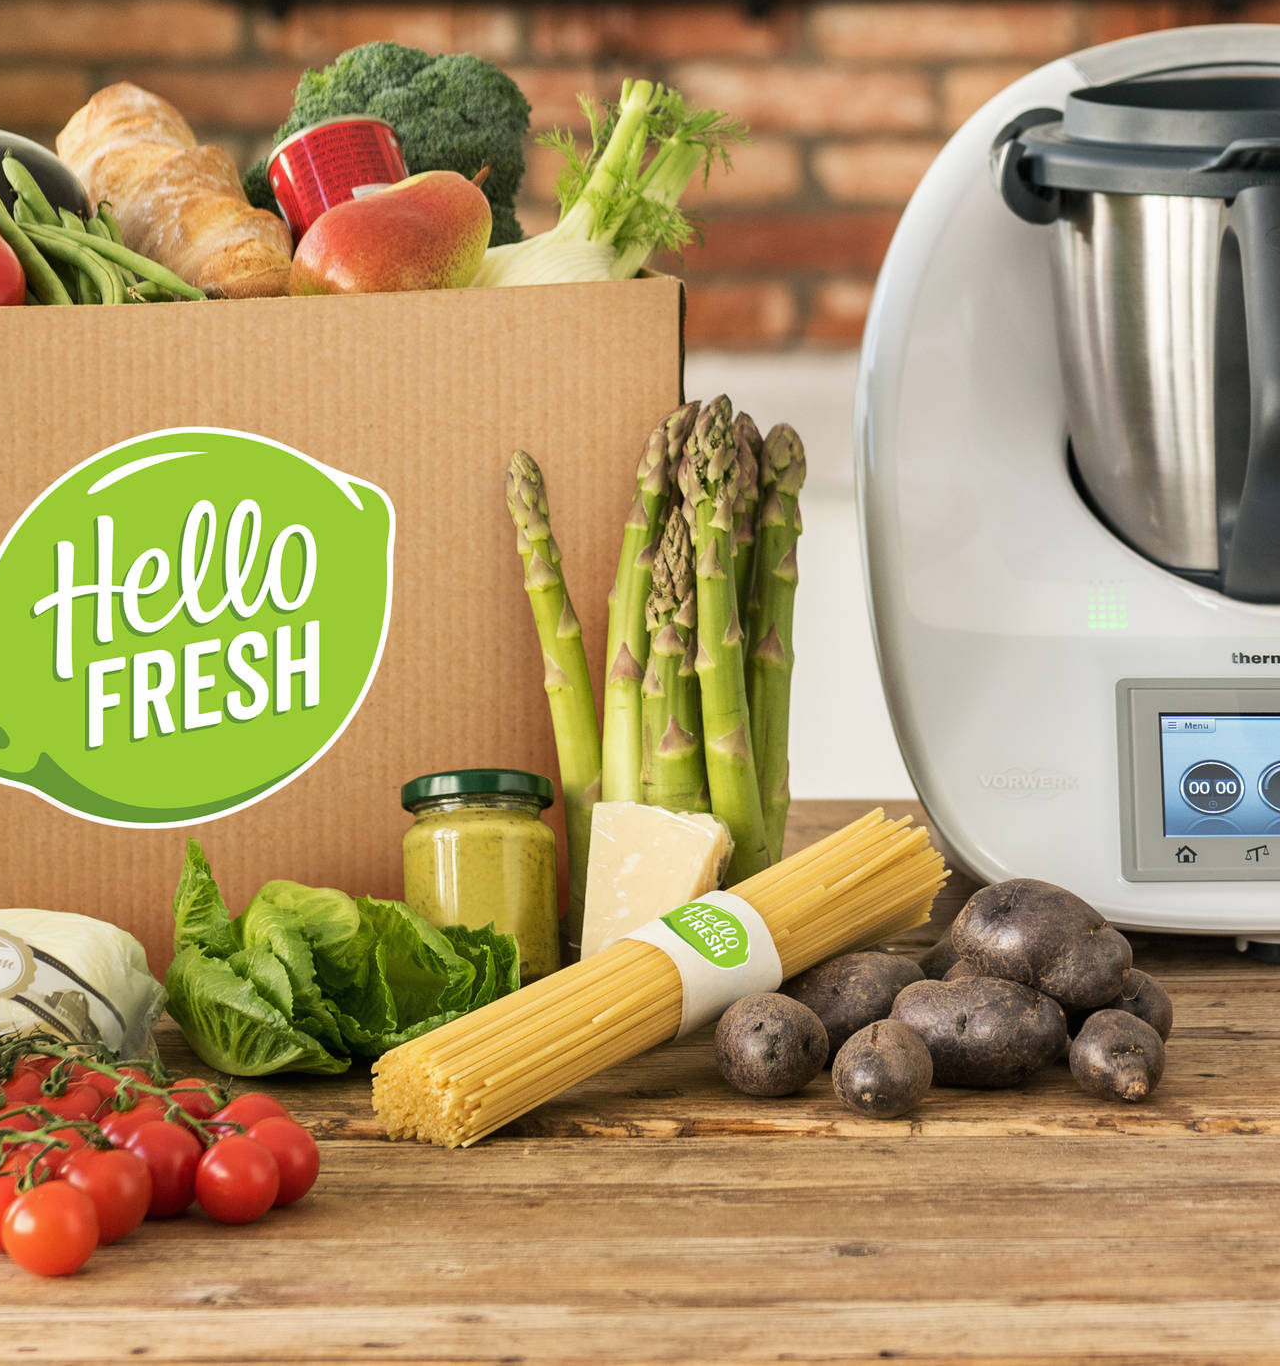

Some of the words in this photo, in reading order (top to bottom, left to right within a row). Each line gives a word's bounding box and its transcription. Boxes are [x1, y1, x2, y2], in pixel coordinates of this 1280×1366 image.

[31, 498, 318, 681] Hello
[86, 620, 320, 749] FRESH
[1184, 720, 1209, 730] Menu
[1188, 781, 1210, 795] 00
[1215, 781, 1237, 795] 00
[679, 914, 728, 958] FRESH
[681, 905, 740, 950] Hello
